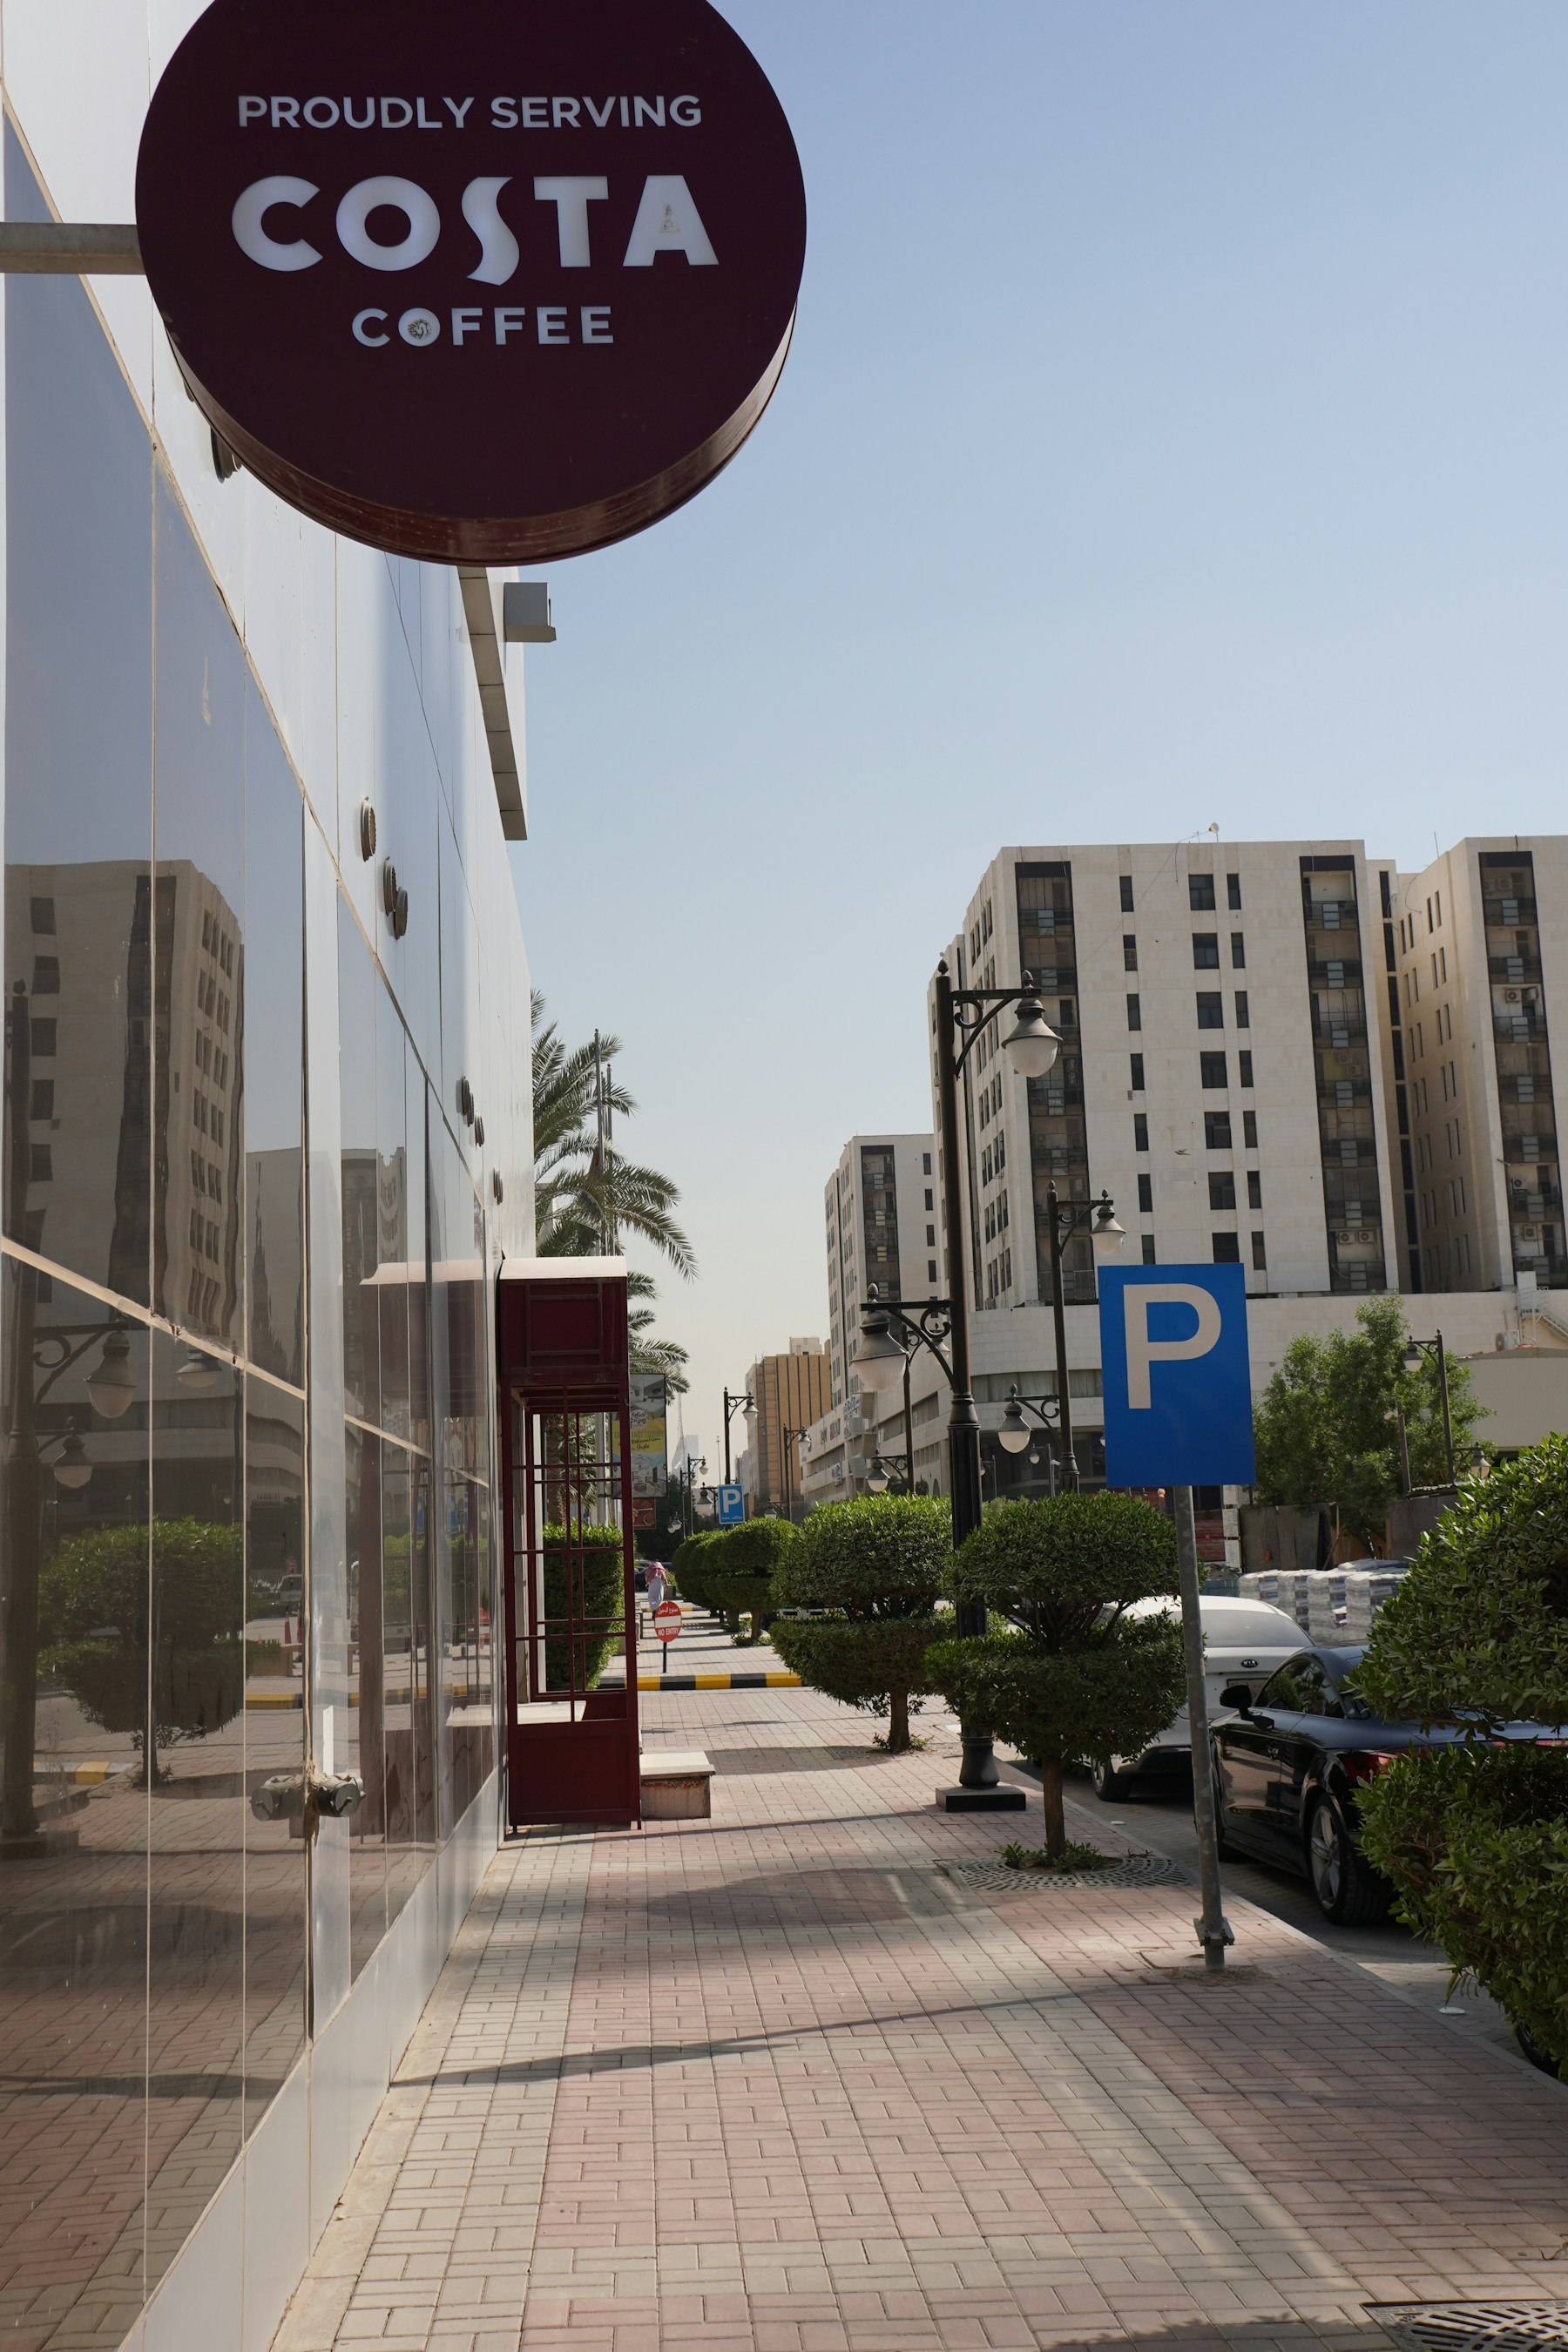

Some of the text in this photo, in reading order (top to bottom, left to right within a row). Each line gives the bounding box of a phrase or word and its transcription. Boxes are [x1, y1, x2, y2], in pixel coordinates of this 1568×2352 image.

[239, 95, 701, 128] PROUDLY SERVING
[232, 175, 720, 286] COSTA
[352, 307, 614, 348] COFFEE
[1123, 1283, 1221, 1409] P
[723, 1490, 740, 1513] P
